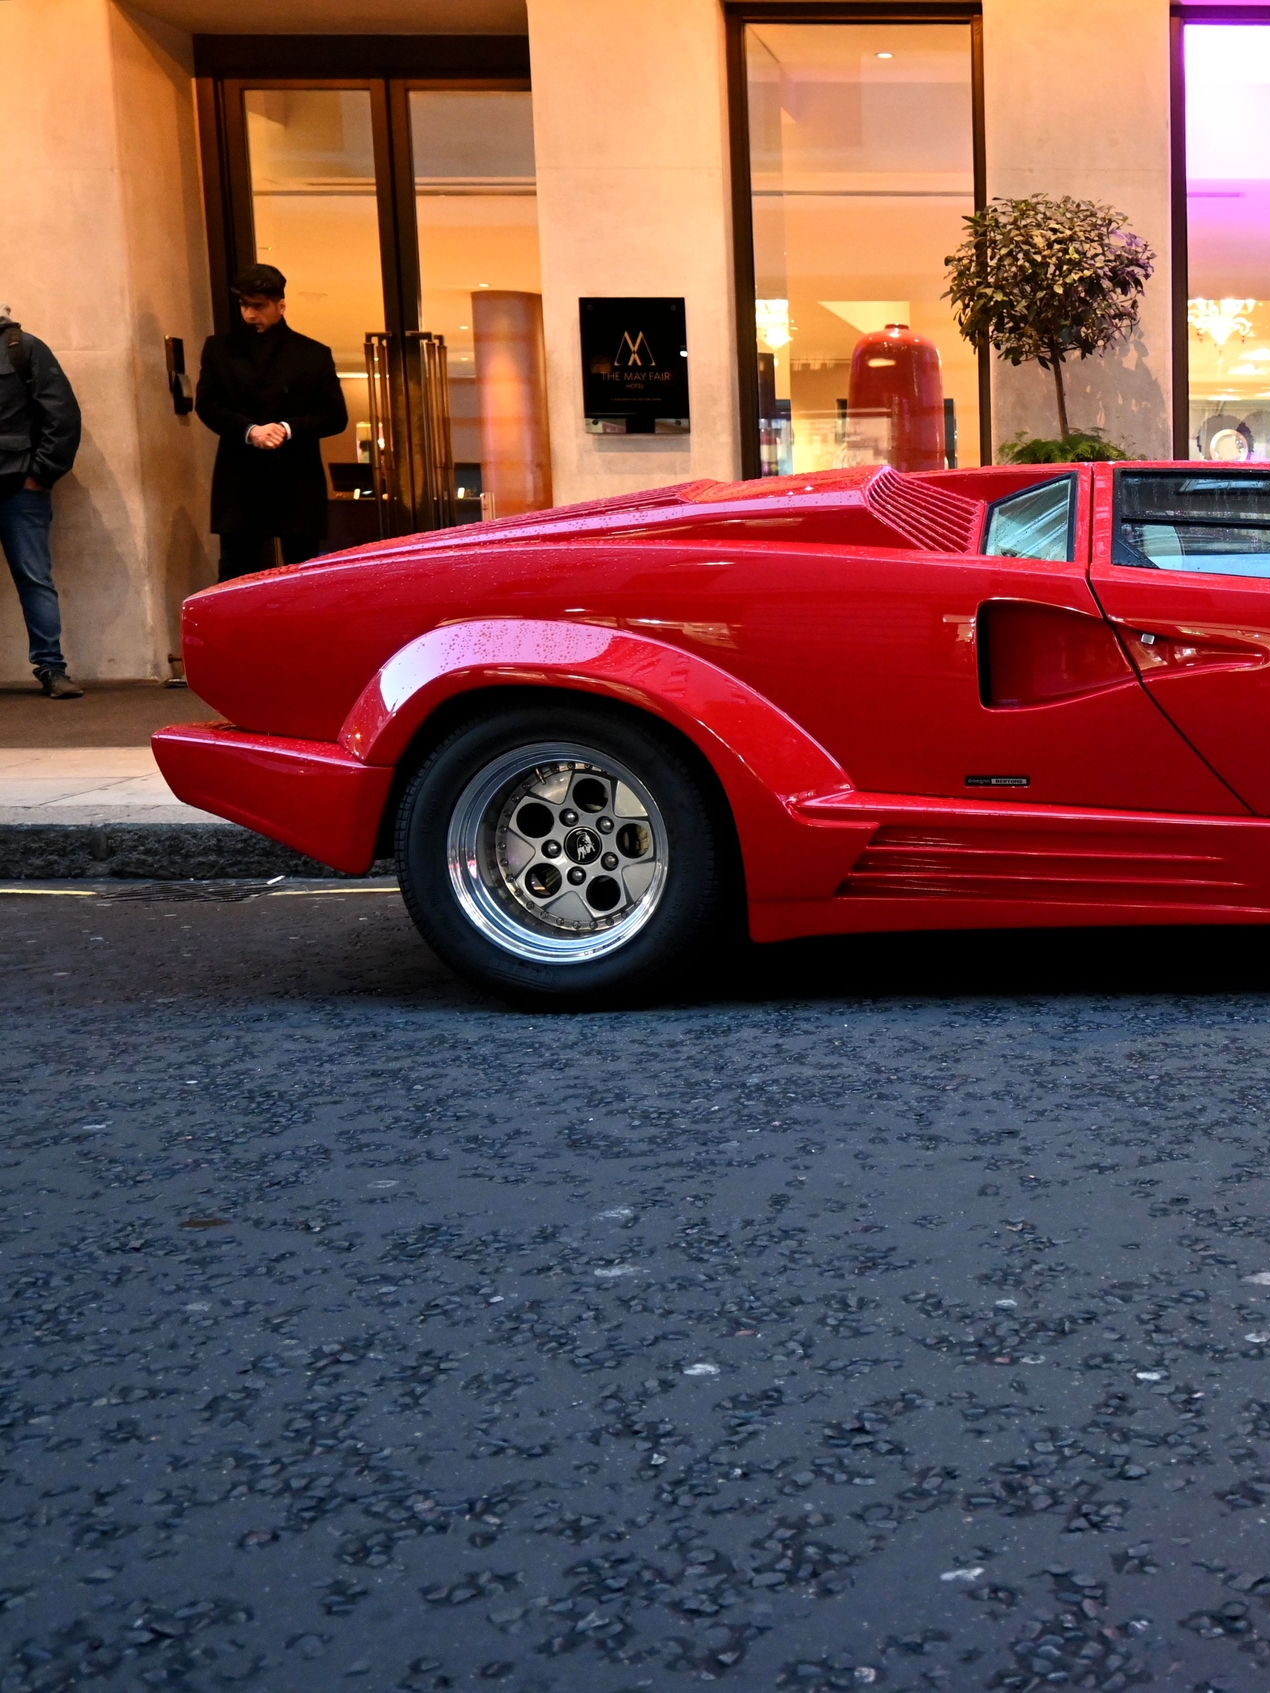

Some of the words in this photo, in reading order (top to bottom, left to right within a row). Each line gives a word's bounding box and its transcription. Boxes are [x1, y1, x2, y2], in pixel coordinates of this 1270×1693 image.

[600, 371, 621, 381] THE
[624, 371, 647, 381] MAY
[649, 371, 671, 381] FAIR
